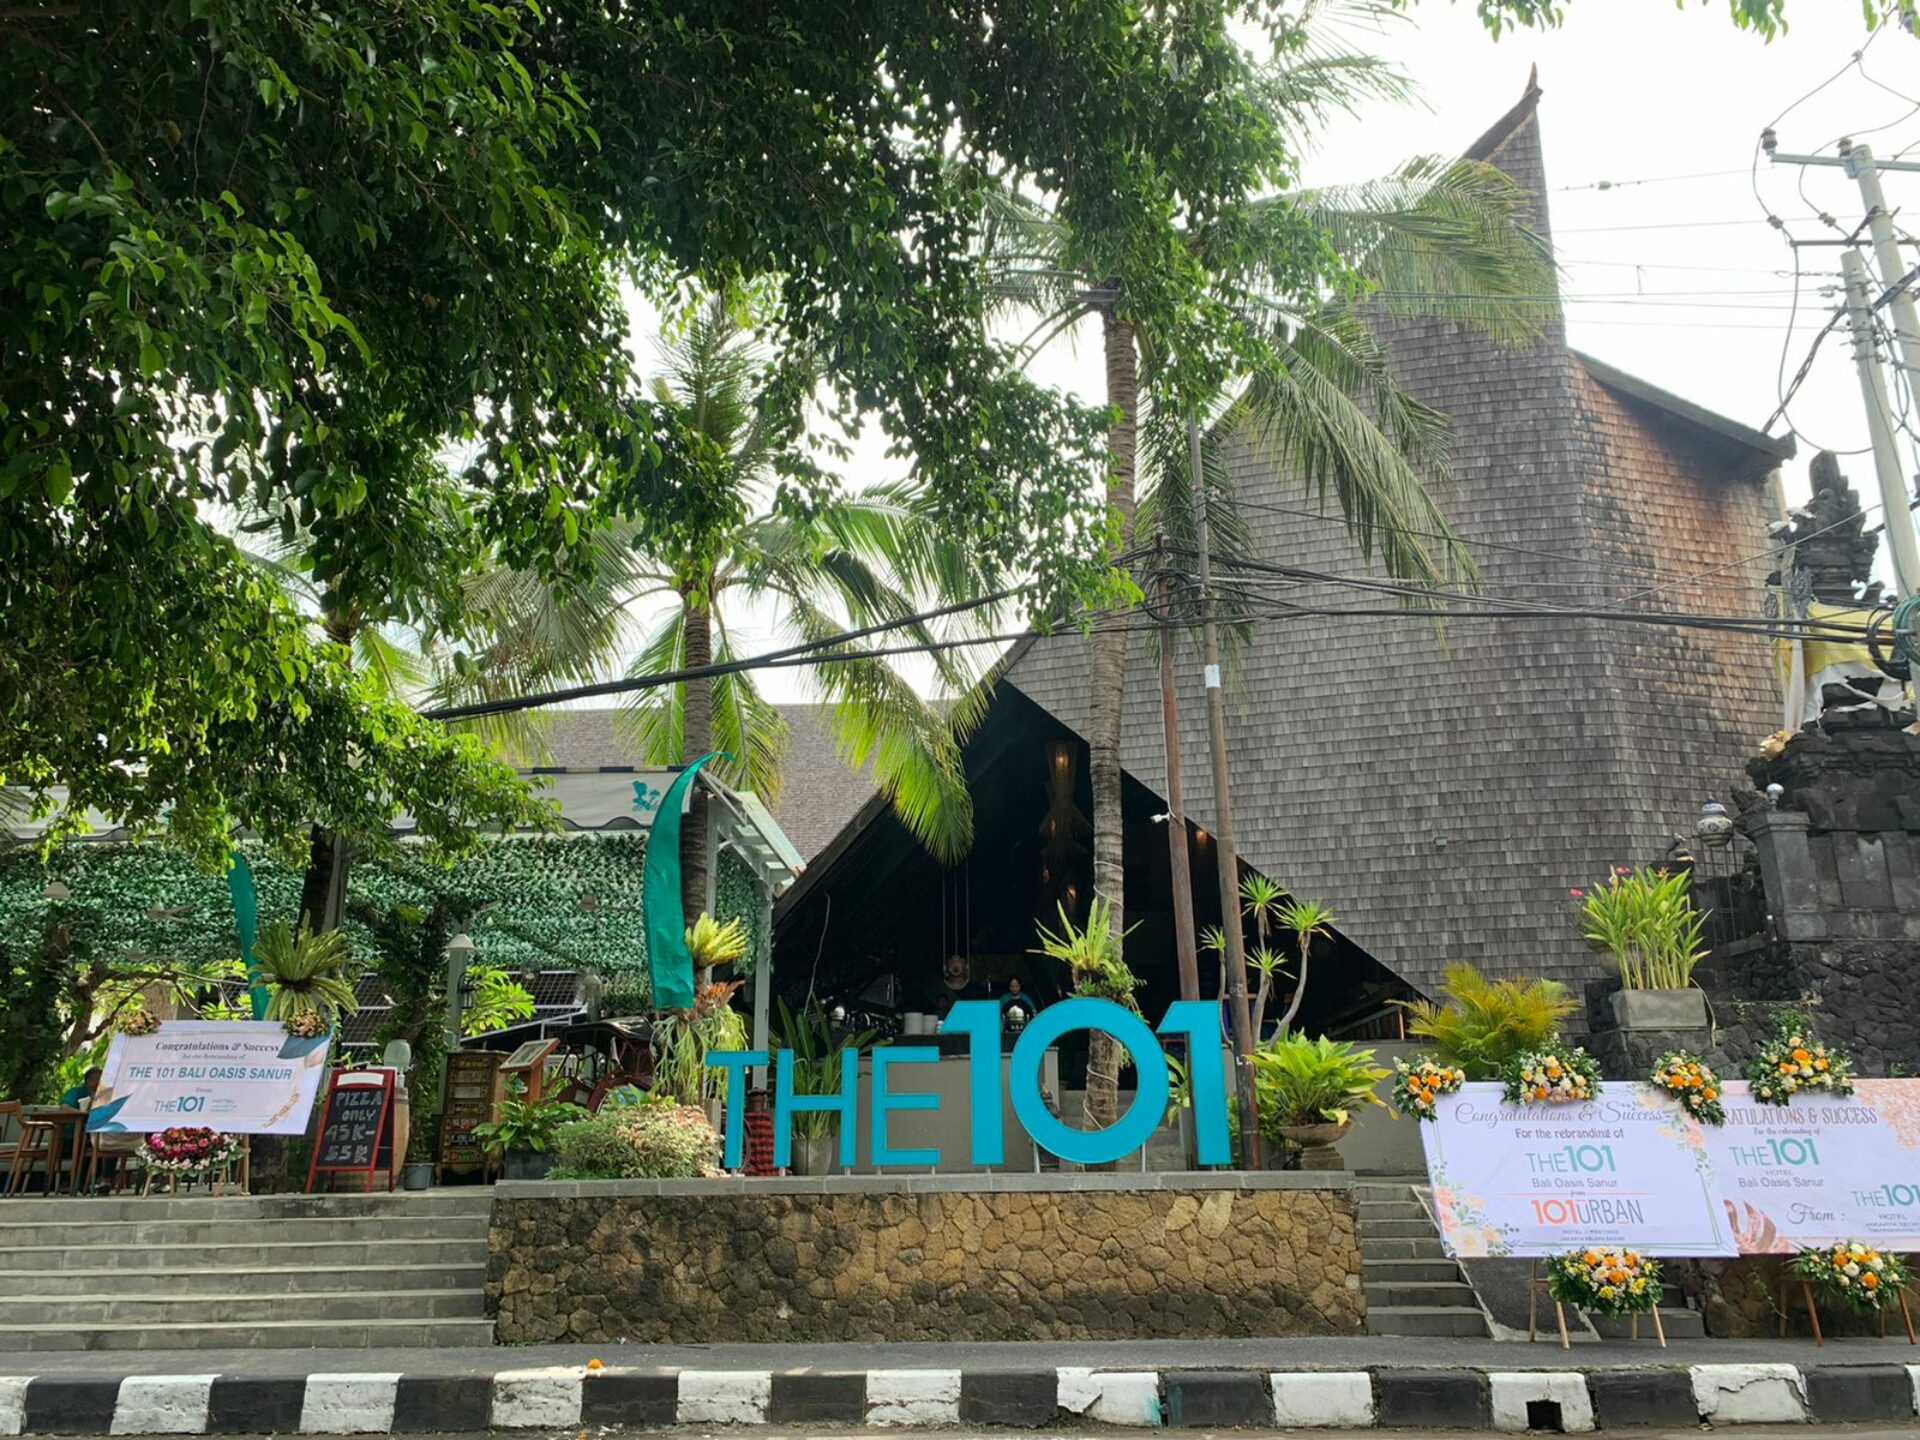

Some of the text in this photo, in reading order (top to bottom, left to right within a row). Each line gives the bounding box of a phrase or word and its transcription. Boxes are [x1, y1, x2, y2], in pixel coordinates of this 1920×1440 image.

[155, 1042, 229, 1052] Congratulations
[244, 1042, 280, 1051] Success
[129, 1067, 293, 1080] THE 101 BALI OASIS SANUR
[1455, 1100, 1665, 1129] Congratulations & Success
[1808, 1107, 1818, 1124] &
[1822, 1107, 1878, 1124] SUCCESS
[1514, 1127, 1624, 1141] For the rebranding of
[1531, 1177, 1618, 1188] Bali Oasis Sanur
[1739, 1176, 1824, 1187] Bali Oasis Sanur
